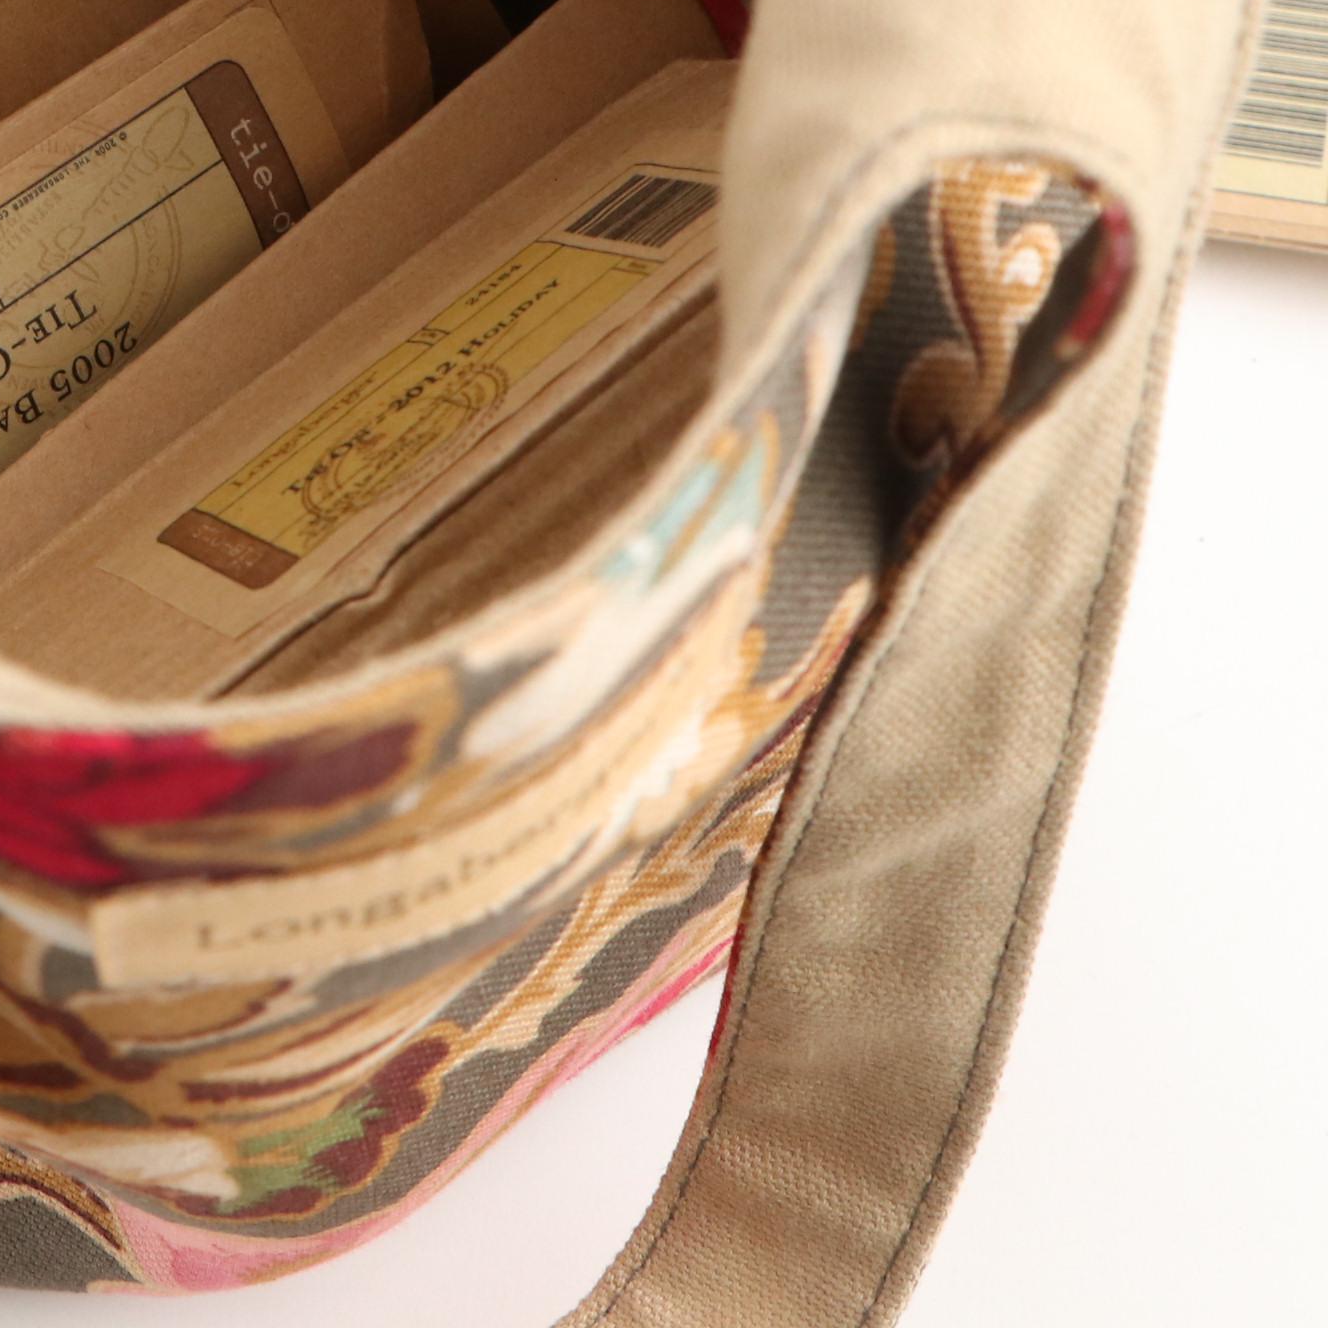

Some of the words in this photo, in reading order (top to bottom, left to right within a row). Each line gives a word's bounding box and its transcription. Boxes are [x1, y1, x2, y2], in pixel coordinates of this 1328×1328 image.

[12, 169, 71, 211] LONGABERGER
[74, 156, 90, 170] THE
[230, 117, 295, 233] tie-o
[49, 320, 138, 402] 2005
[388, 360, 458, 412] 2012
[457, 277, 560, 357] HOLIDAY
